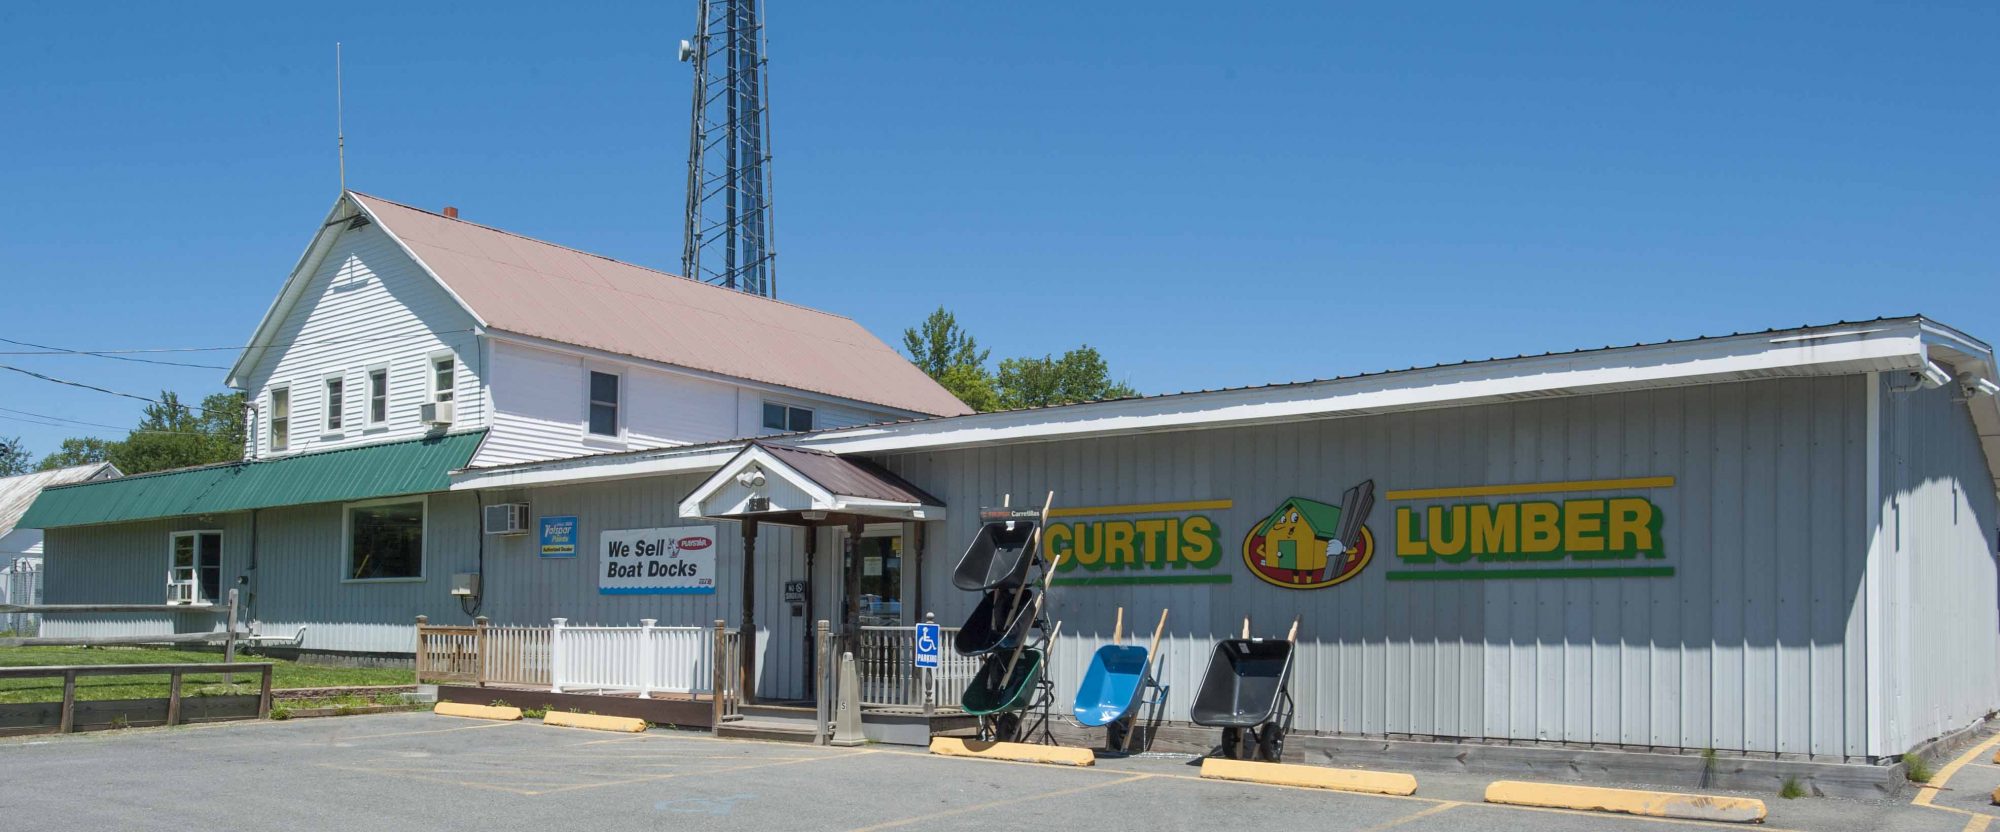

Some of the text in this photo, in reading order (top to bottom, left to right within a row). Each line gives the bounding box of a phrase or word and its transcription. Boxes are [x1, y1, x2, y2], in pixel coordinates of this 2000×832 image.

[1043, 497, 1666, 572] CURTIS LUMBER
[608, 539, 665, 557] We Sell
[607, 560, 697, 578] Boat Docks
[917, 653, 937, 663] PARKING
